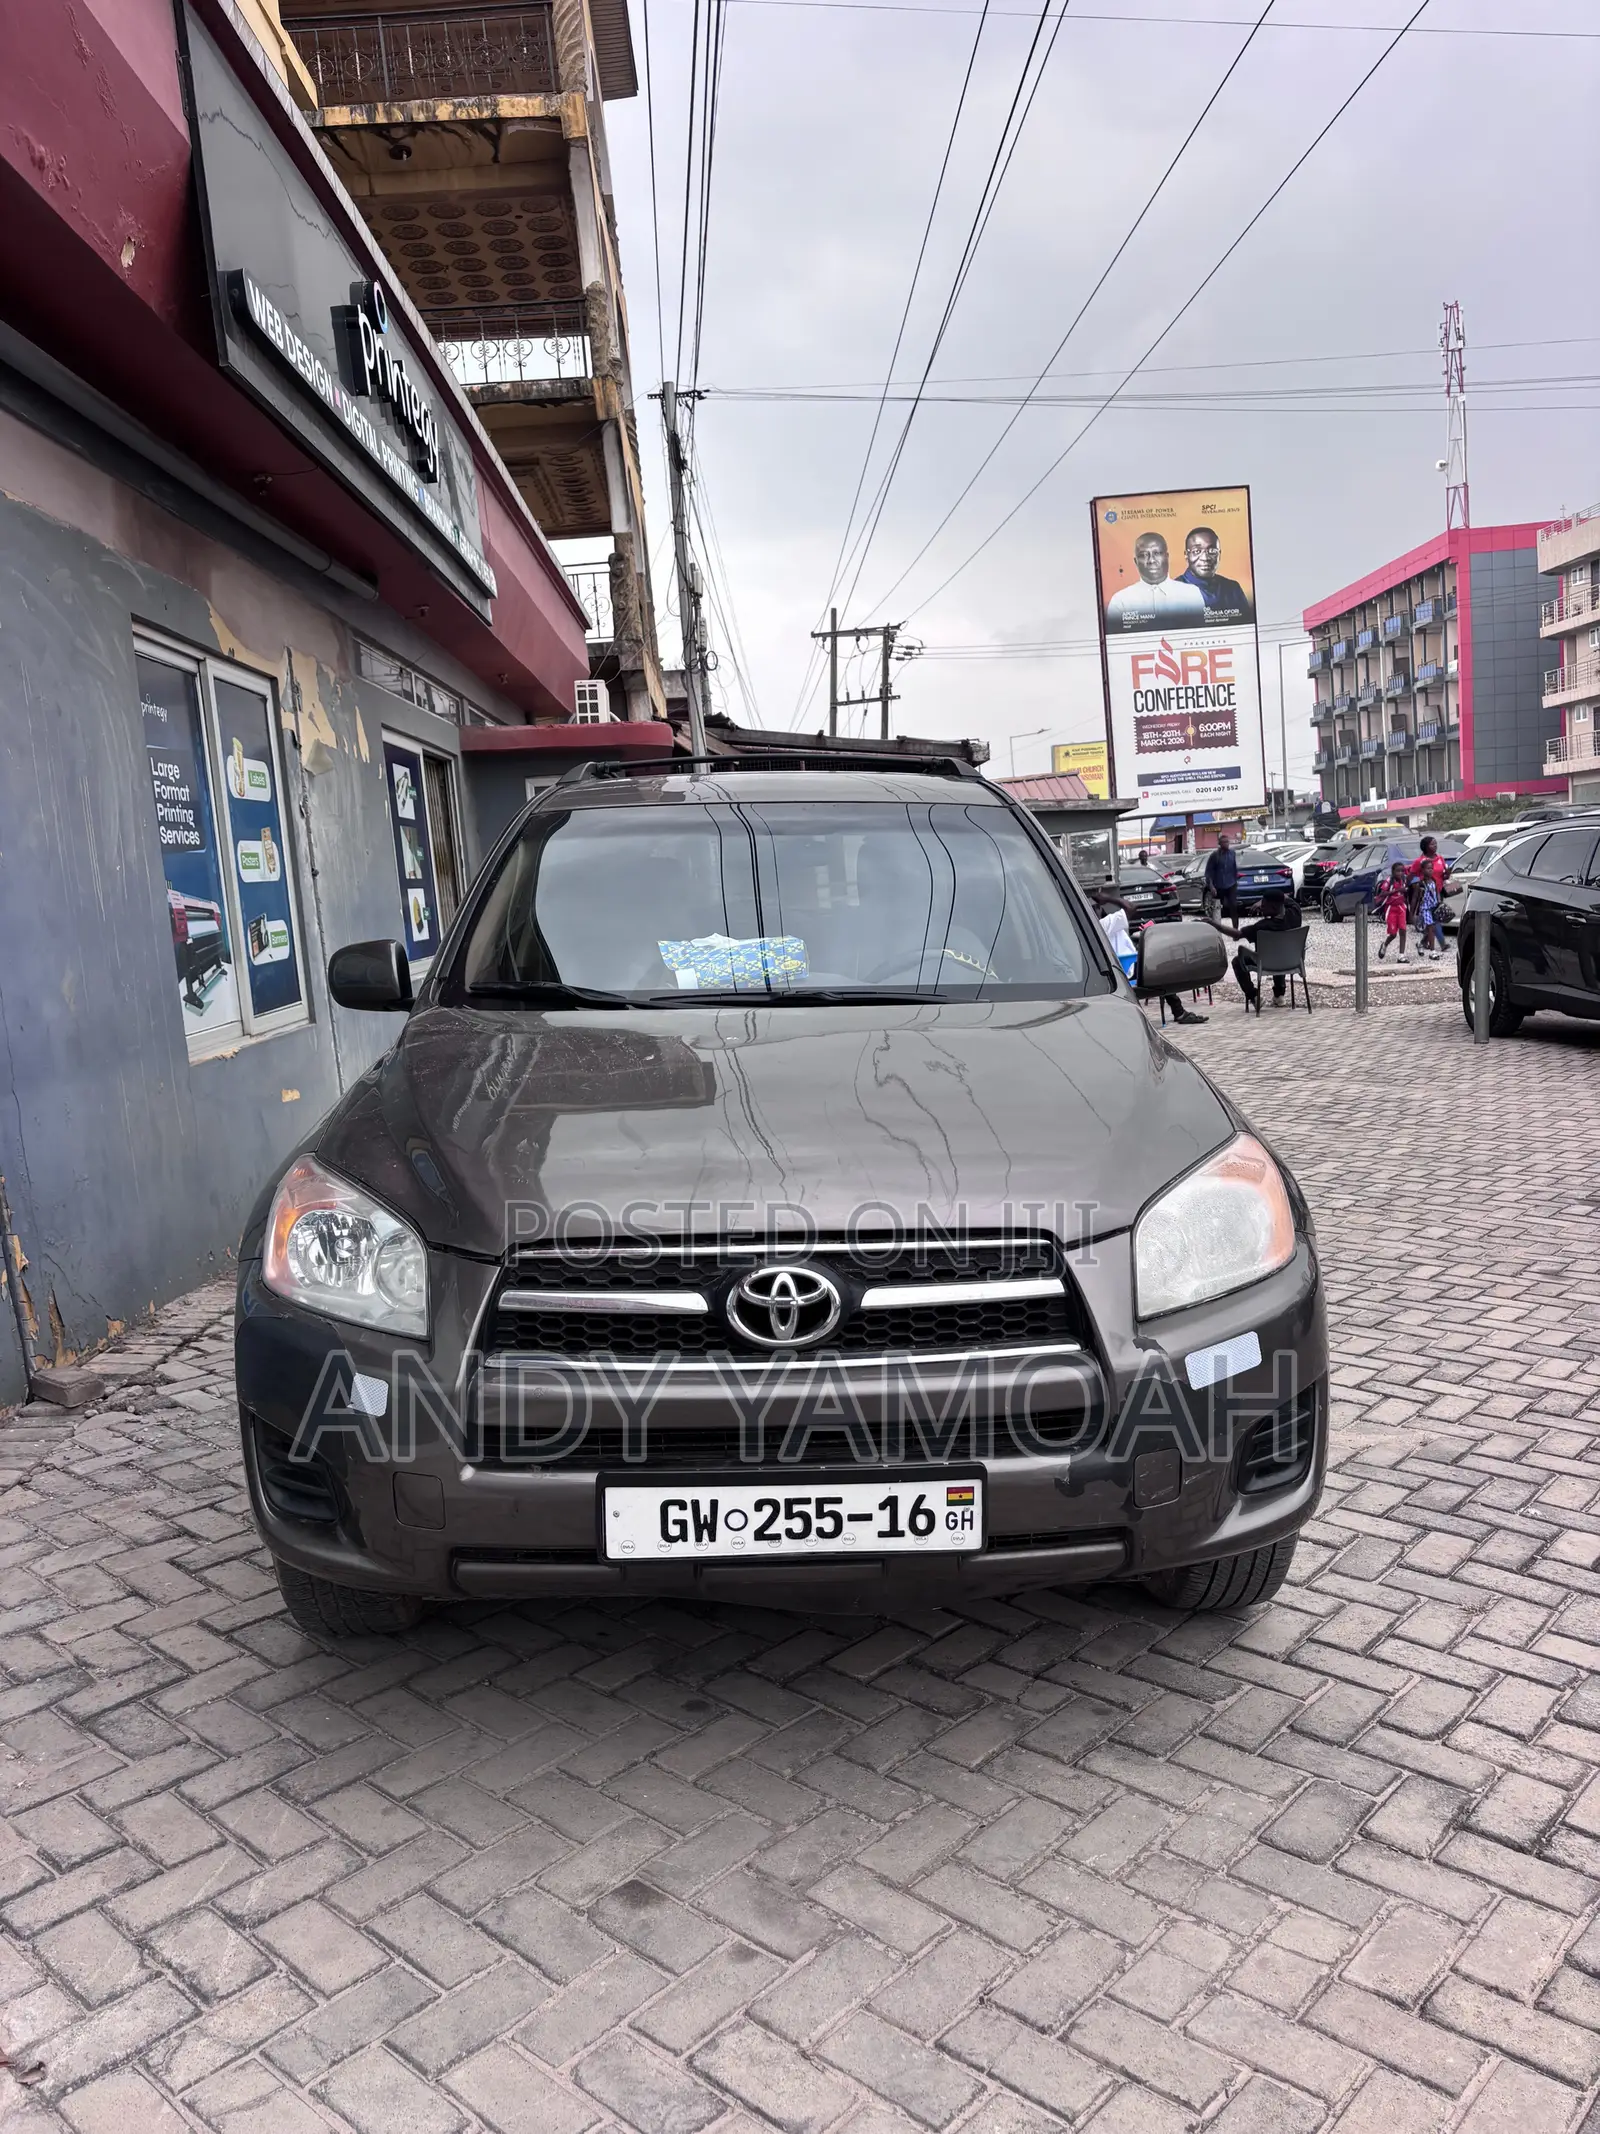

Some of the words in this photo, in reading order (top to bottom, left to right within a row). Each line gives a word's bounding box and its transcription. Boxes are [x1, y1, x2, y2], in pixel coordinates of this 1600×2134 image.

[247, 278, 284, 350] WEB
[284, 322, 334, 407] DESIGN
[341, 391, 381, 460] DIGITAL
[381, 439, 419, 503] PRINTING
[357, 280, 440, 483] printegy
[141, 693, 168, 723] printegy
[1133, 683, 1236, 713] CONFERENCE
[1199, 721, 1231, 732] 6:00PM
[1167, 737, 1185, 745] 2026
[150, 757, 180, 783] Large
[1083, 765, 1105, 773] CHURCH
[153, 780, 190, 802] Format
[156, 802, 195, 828] Printing
[159, 825, 200, 845] Services
[660, 1499, 719, 1543] GW
[754, 1494, 936, 1541] 255-16
[945, 1510, 973, 1531] GH
